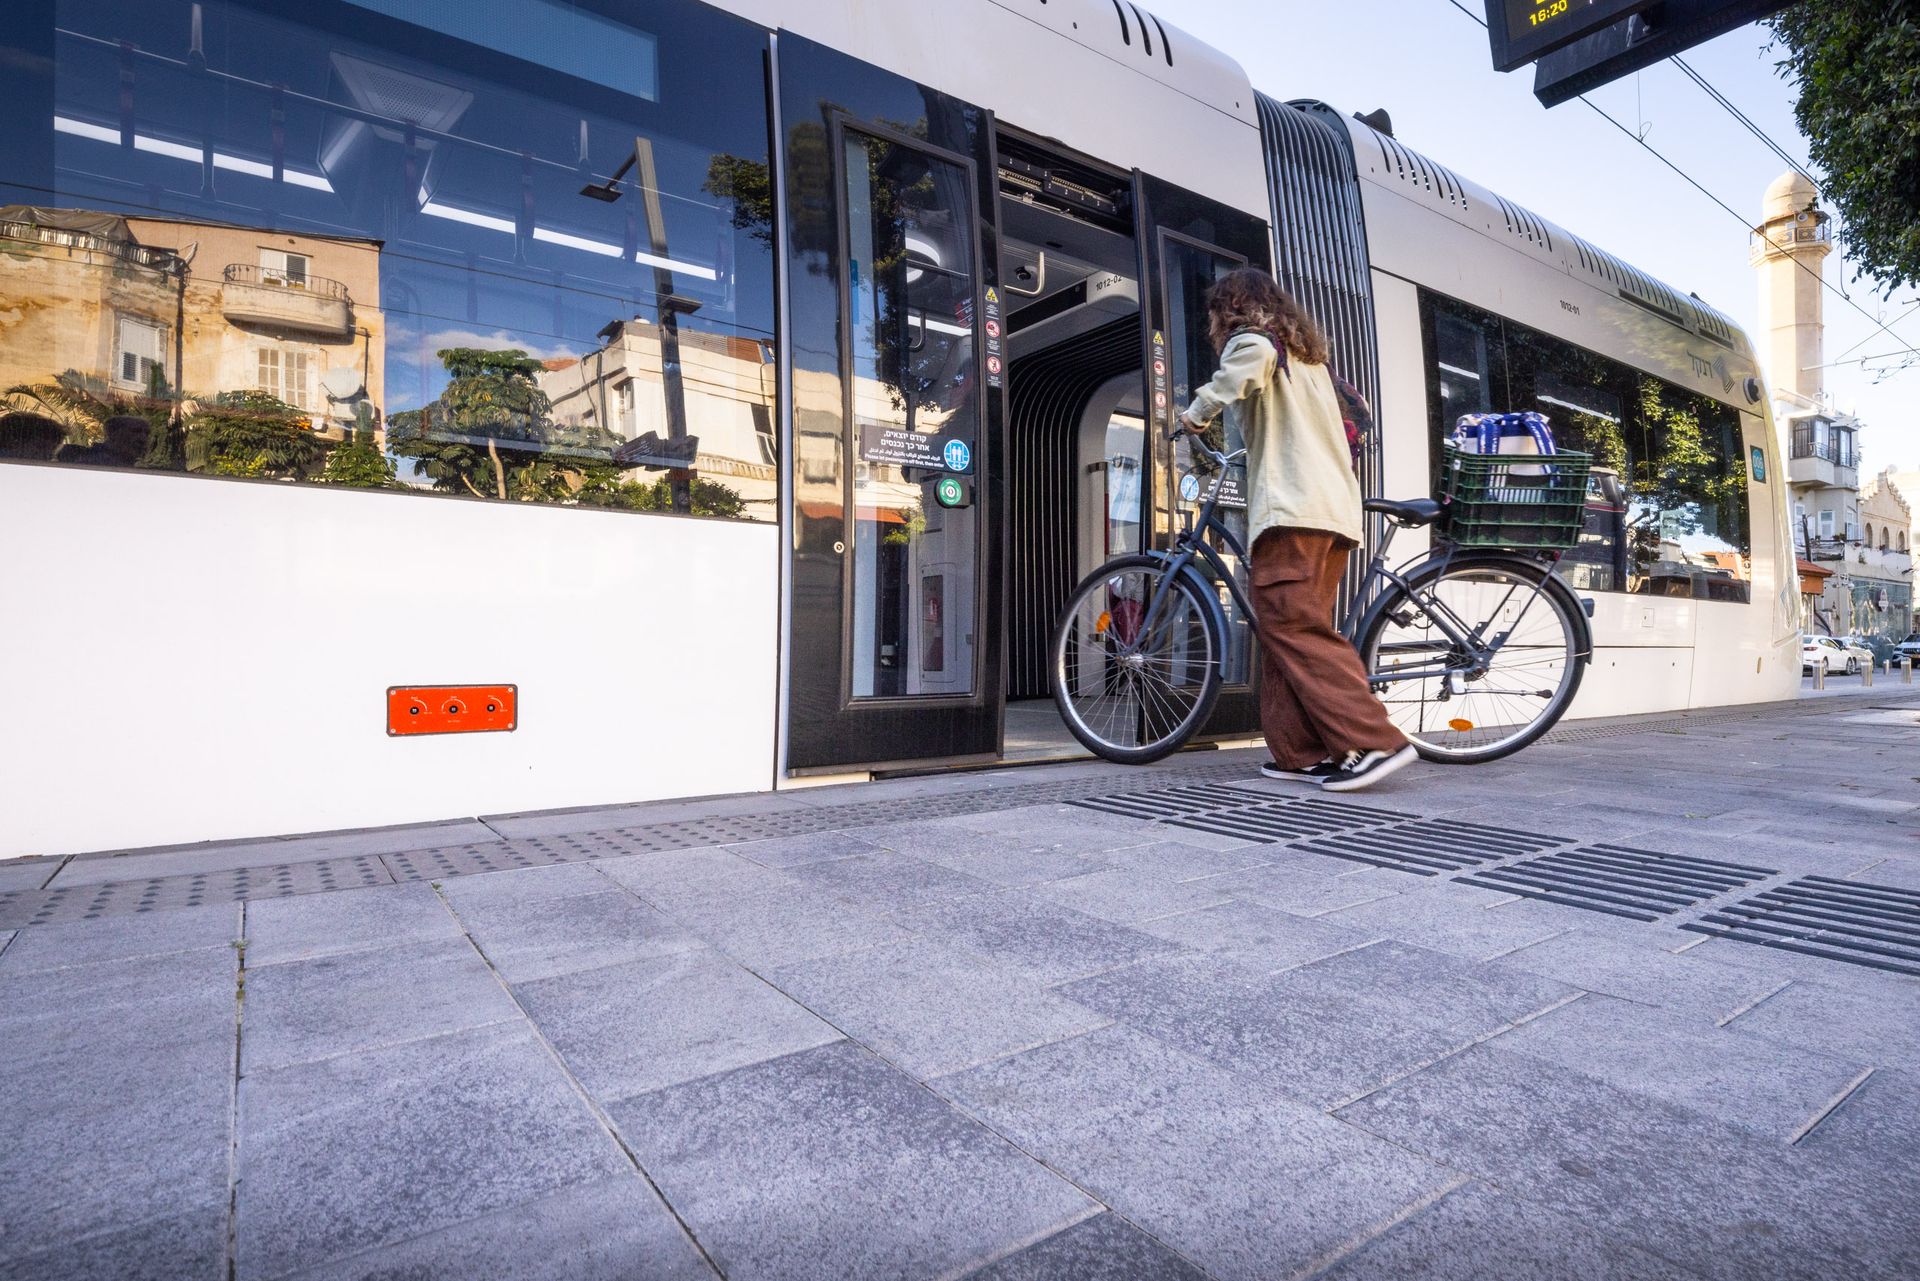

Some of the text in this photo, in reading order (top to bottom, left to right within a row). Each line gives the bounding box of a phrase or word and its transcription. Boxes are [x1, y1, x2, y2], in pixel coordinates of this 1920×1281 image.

[1529, 0, 1569, 26] 16:20
[1096, 274, 1122, 291] 1012-02
[1559, 299, 1580, 316] 1012-01
[881, 439, 904, 447] נכנסים
[910, 435, 927, 443] קודם
[905, 442, 915, 450] כך
